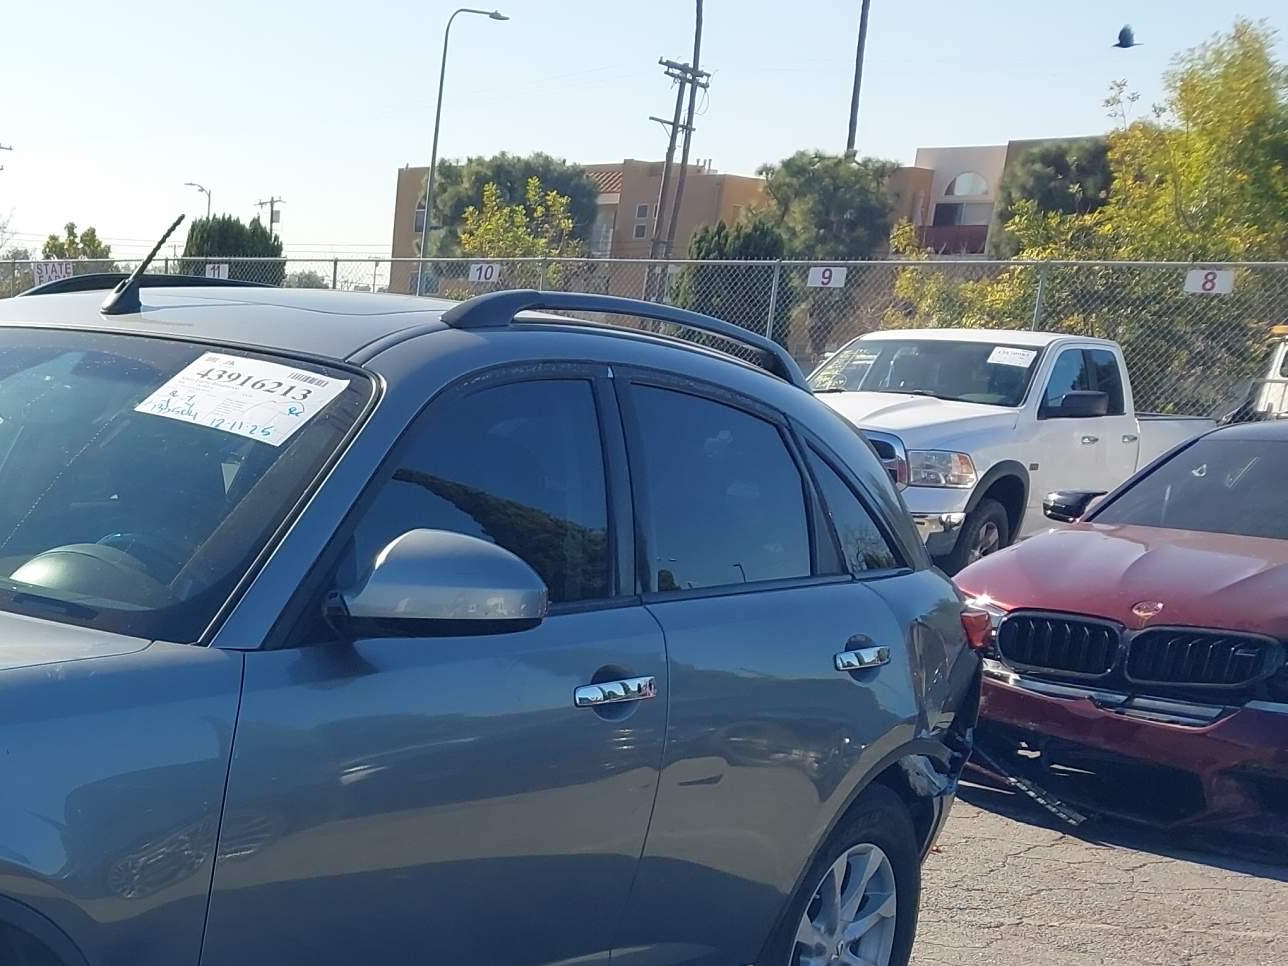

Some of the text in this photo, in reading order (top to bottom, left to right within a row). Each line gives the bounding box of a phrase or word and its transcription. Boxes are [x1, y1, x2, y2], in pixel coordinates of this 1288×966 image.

[36, 263, 72, 275] STATE
[210, 265, 220, 278] 11
[476, 264, 494, 281] 10
[821, 268, 833, 286] 9
[1202, 271, 1218, 291] 8
[196, 367, 313, 401] 43916213
